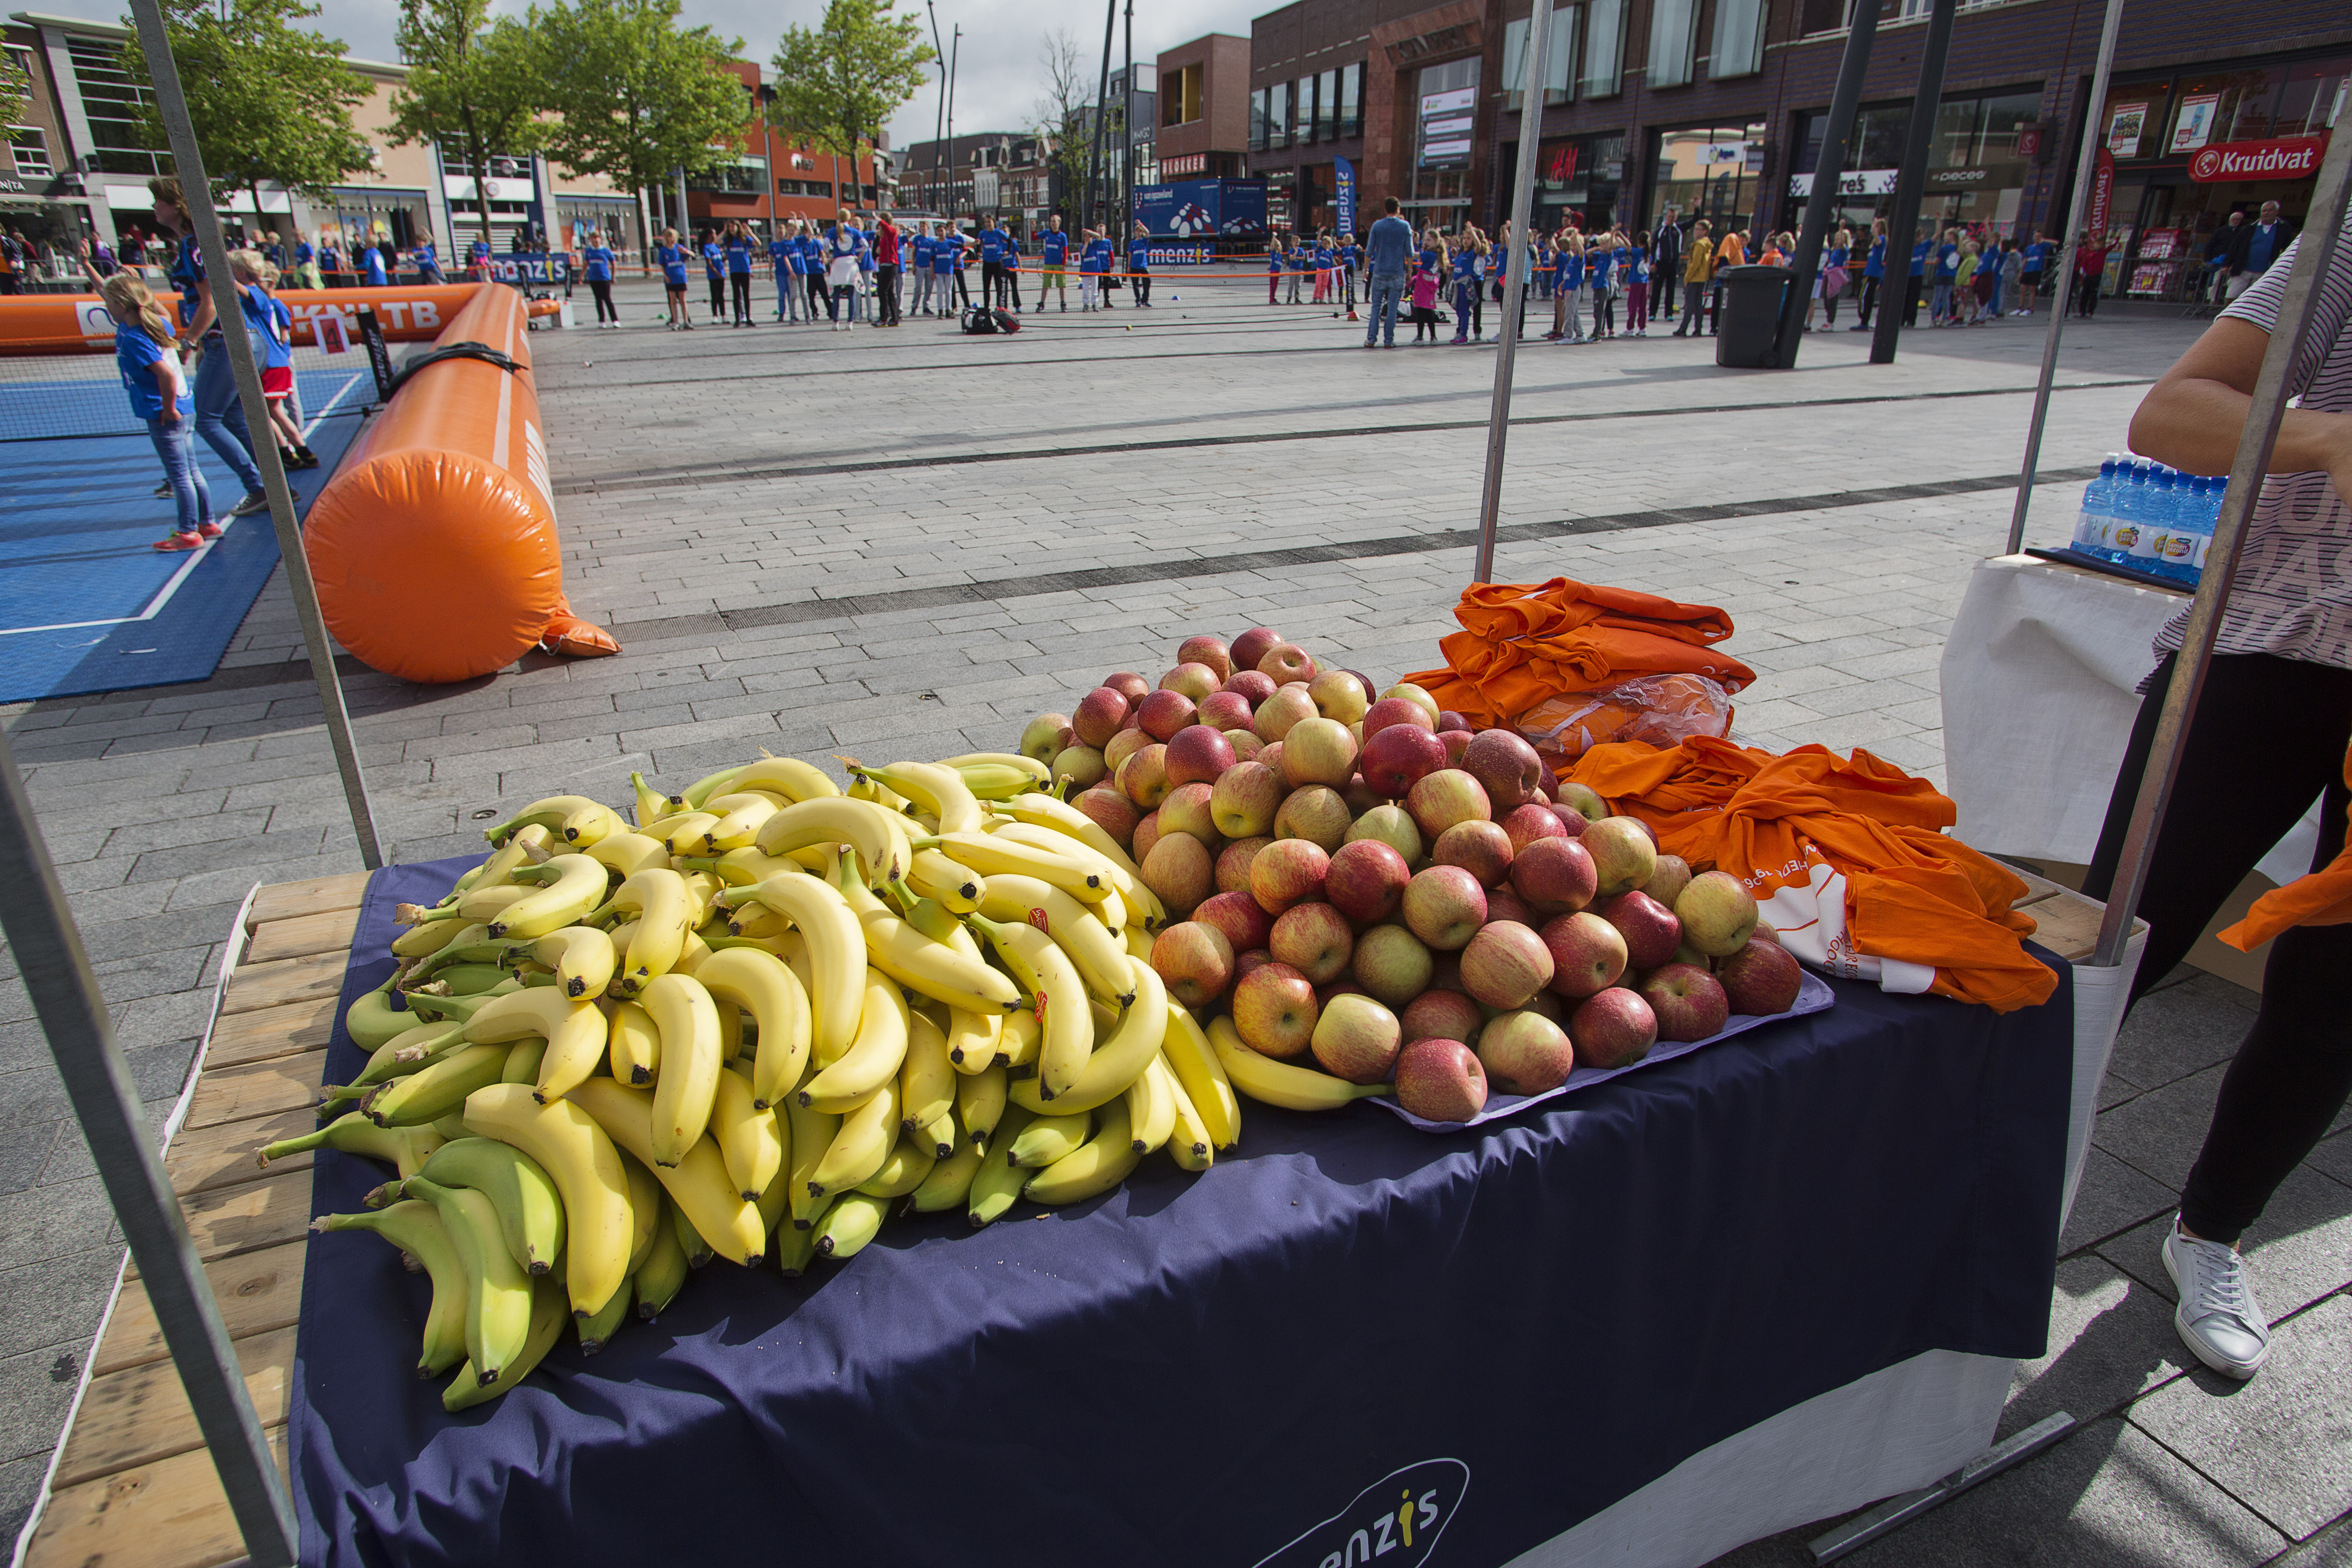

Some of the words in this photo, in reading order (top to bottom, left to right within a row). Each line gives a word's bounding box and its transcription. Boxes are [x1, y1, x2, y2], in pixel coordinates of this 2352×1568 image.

[1162, 155, 1205, 175] BLOKKER
[2220, 147, 2314, 173] Kruidvat
[1839, 173, 1866, 192] re's
[1149, 243, 1210, 265] menzis
[492, 254, 566, 282] nzis
[326, 328, 341, 348] 4
